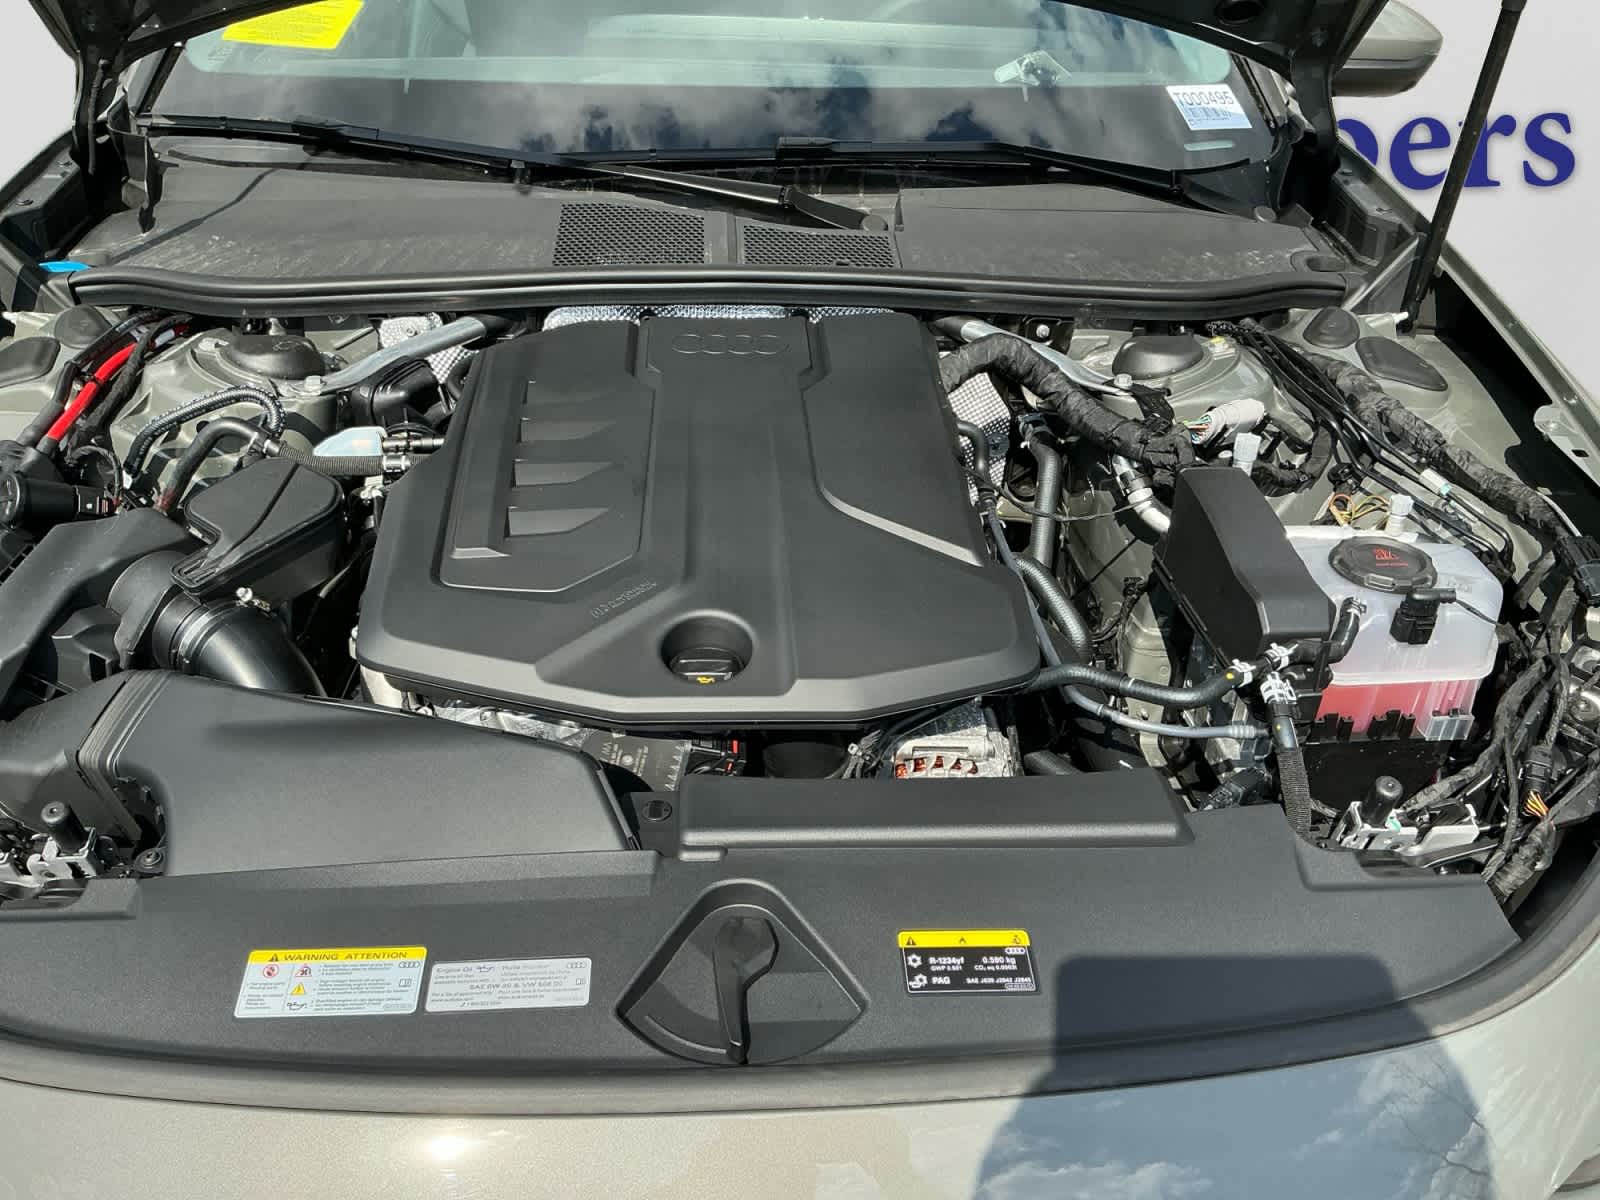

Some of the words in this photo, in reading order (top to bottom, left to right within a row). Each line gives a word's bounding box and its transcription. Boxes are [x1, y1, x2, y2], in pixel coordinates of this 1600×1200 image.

[1172, 90, 1235, 107] T000495
[284, 952, 339, 961] WARNING
[345, 951, 408, 960] ATTENTION
[929, 956, 965, 966] R-1234yf
[1005, 957, 1017, 966] kg
[931, 976, 951, 985] PAG
